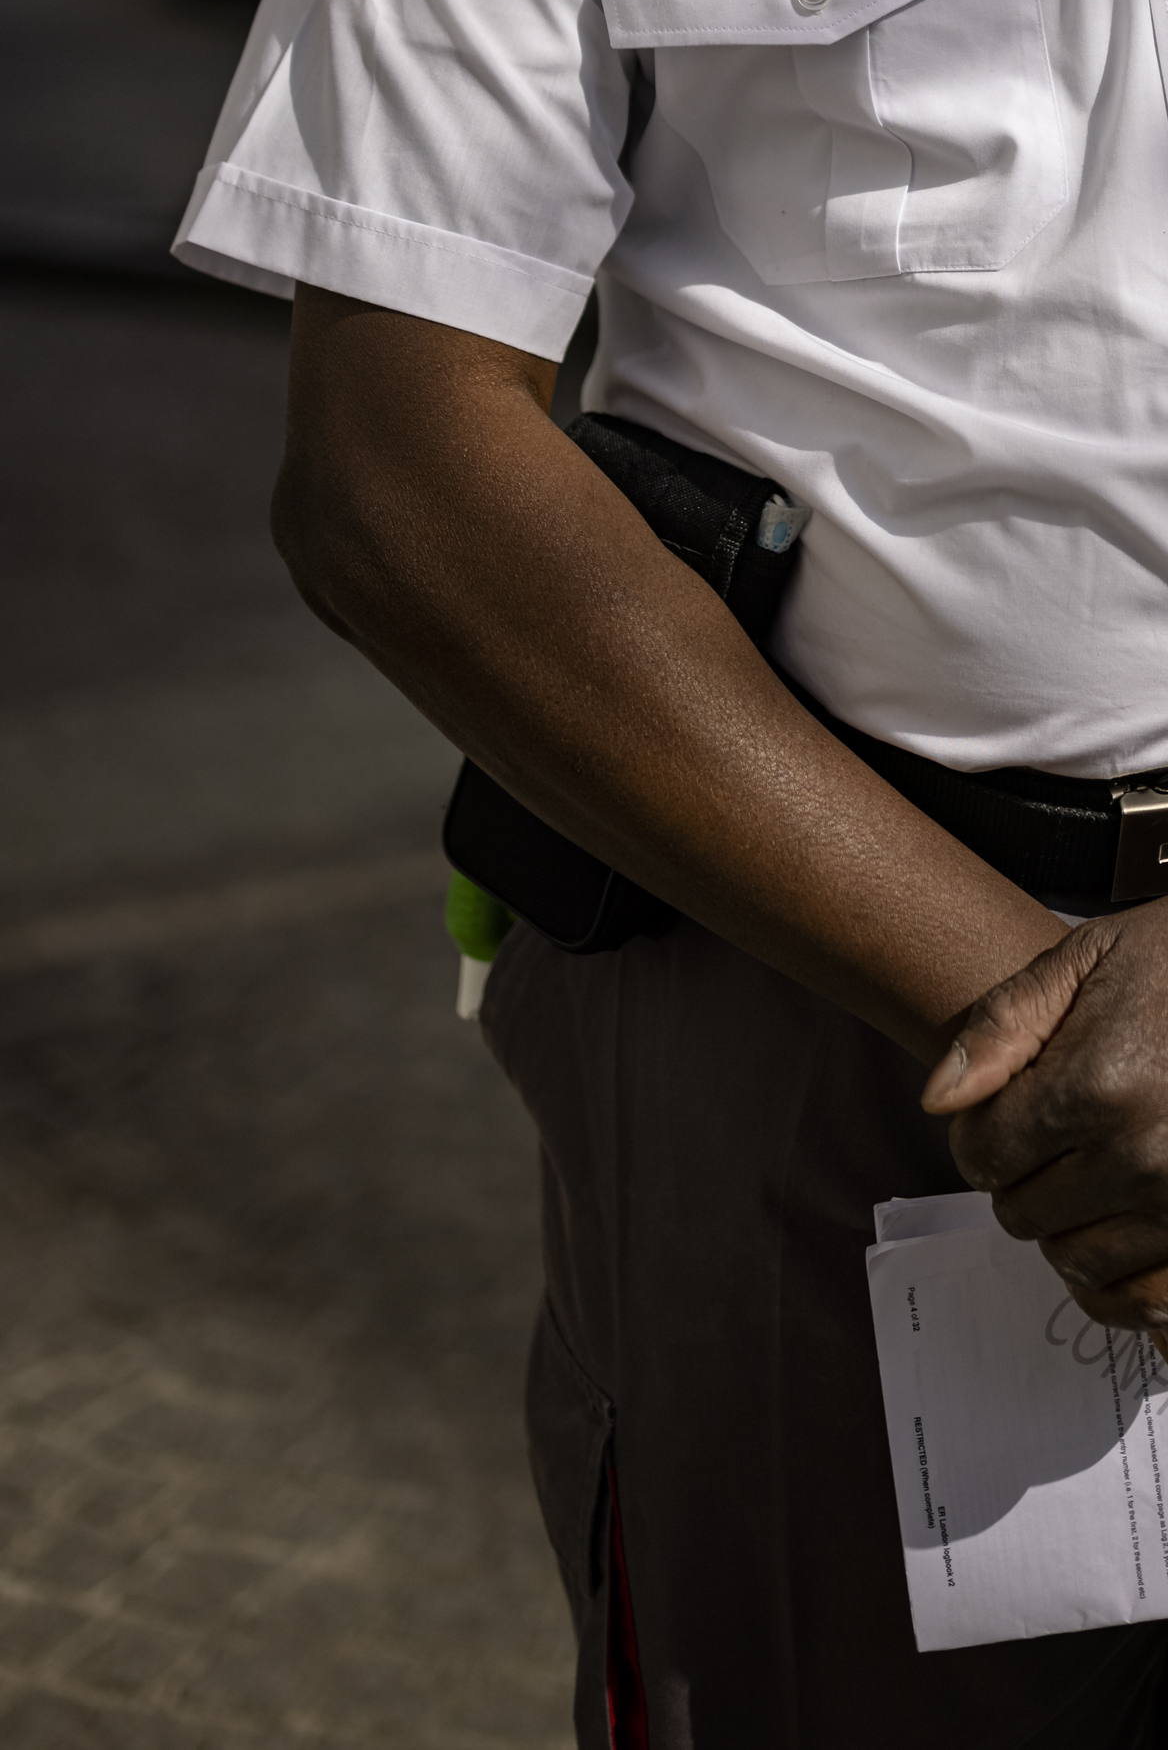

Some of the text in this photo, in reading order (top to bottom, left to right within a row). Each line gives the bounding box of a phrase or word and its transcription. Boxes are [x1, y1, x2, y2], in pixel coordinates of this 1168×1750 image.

[906, 1286, 917, 1305] Page
[912, 1321, 920, 1331] 32
[1135, 1341, 1146, 1366] (Please
[1139, 1367, 1148, 1382] start
[1111, 1375, 1119, 1397] current
[1145, 1416, 1155, 1436] clearly
[1118, 1438, 1126, 1454] entry
[1149, 1438, 1158, 1462] marked
[913, 1416, 935, 1528] RESTRICTED (When complete)
[1121, 1456, 1130, 1479] number
[1152, 1463, 1158, 1471] on
[1154, 1484, 1162, 1502] cover
[1128, 1510, 1136, 1520] the
[1156, 1503, 1164, 1518] page
[1159, 1520, 1165, 1528] as
[1159, 1529, 1168, 1541] Log
[937, 1505, 955, 1586] ER London logbook v2
[1132, 1541, 1140, 1549] for
[1133, 1551, 1141, 1561] the
[1135, 1562, 1144, 1585] second
[1137, 1586, 1146, 1599] etc)
